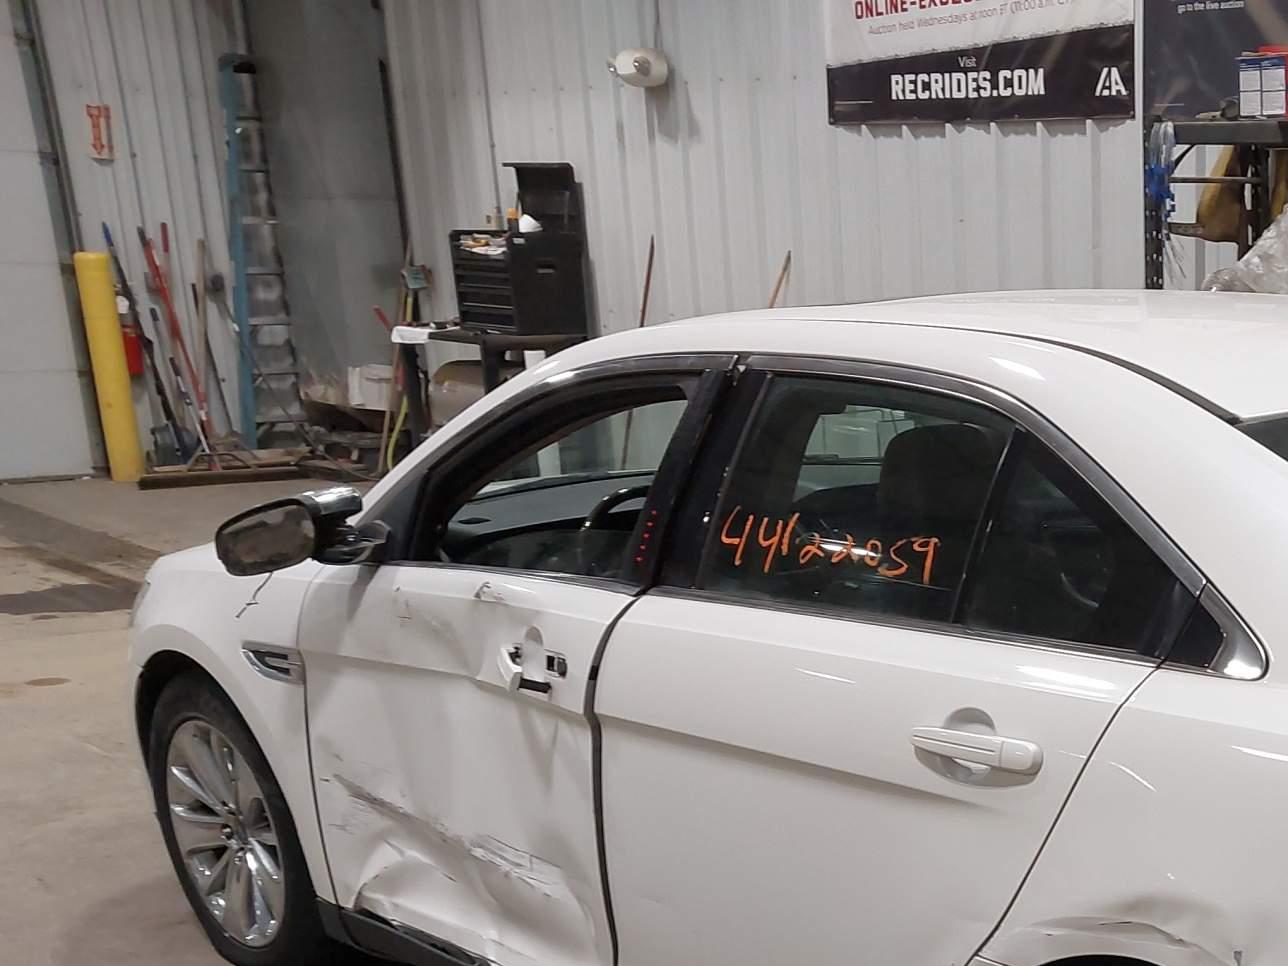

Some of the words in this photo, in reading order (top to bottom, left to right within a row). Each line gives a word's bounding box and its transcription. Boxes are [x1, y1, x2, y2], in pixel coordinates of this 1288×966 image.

[855, 0, 980, 19] ONLINE-E
[958, 56, 977, 68] Visit
[890, 68, 1046, 100] RECRIDES.COM
[720, 505, 941, 585] 44122059
